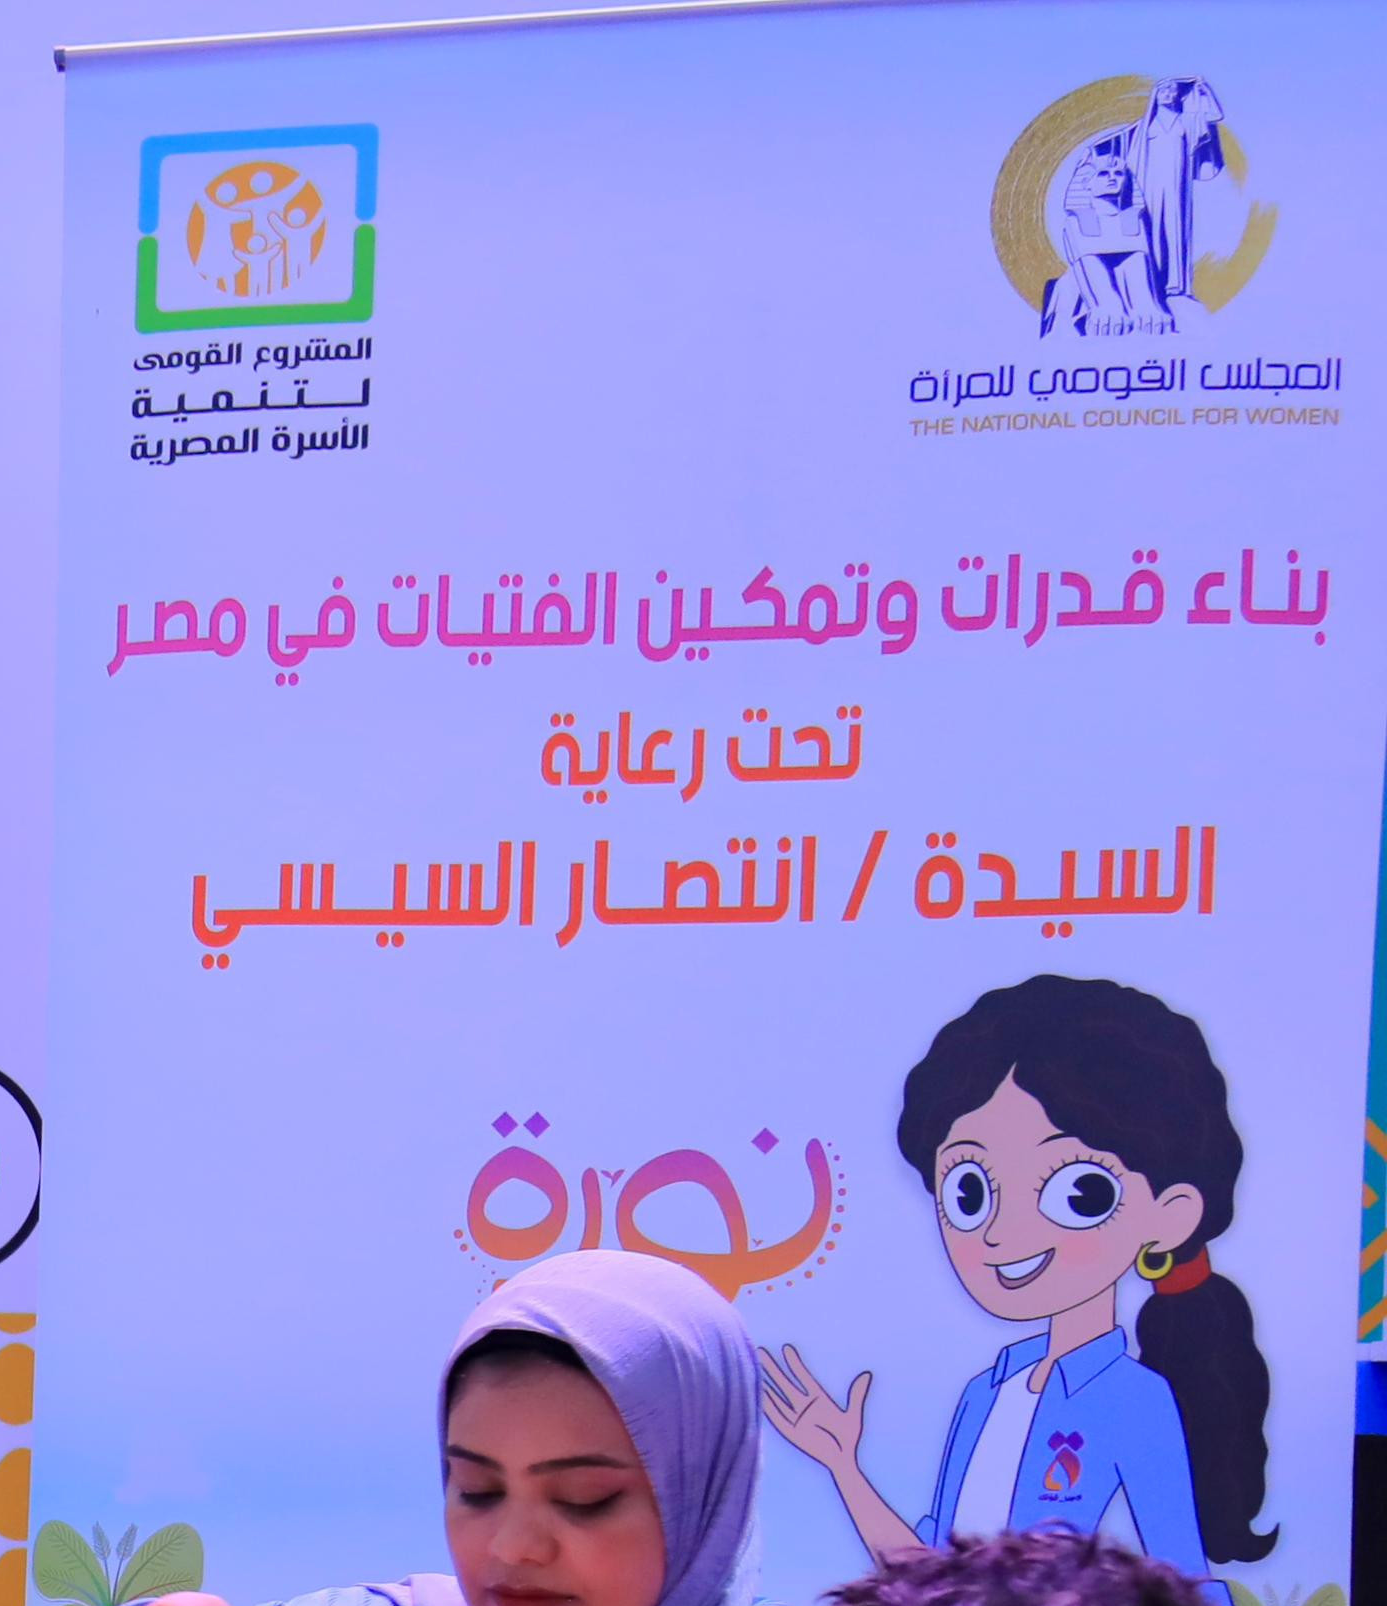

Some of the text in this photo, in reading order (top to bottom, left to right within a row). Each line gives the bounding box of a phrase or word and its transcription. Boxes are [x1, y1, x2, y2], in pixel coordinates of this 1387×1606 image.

[253, 337, 372, 372] المشروع
[909, 357, 1342, 408] المجلس القومي للمرأة
[130, 417, 369, 467] الأسرة المصرية
[909, 406, 1340, 437] THE NATIONAL COUNCIL FOR WOMEN
[106, 547, 1330, 687] بناء قدرات وتمكين الفتيات في مصر
[541, 704, 863, 806] تحت رعاية
[190, 840, 537, 971] السيسي
[555, 834, 818, 948] انتصار
[914, 825, 1218, 940] السيدة
